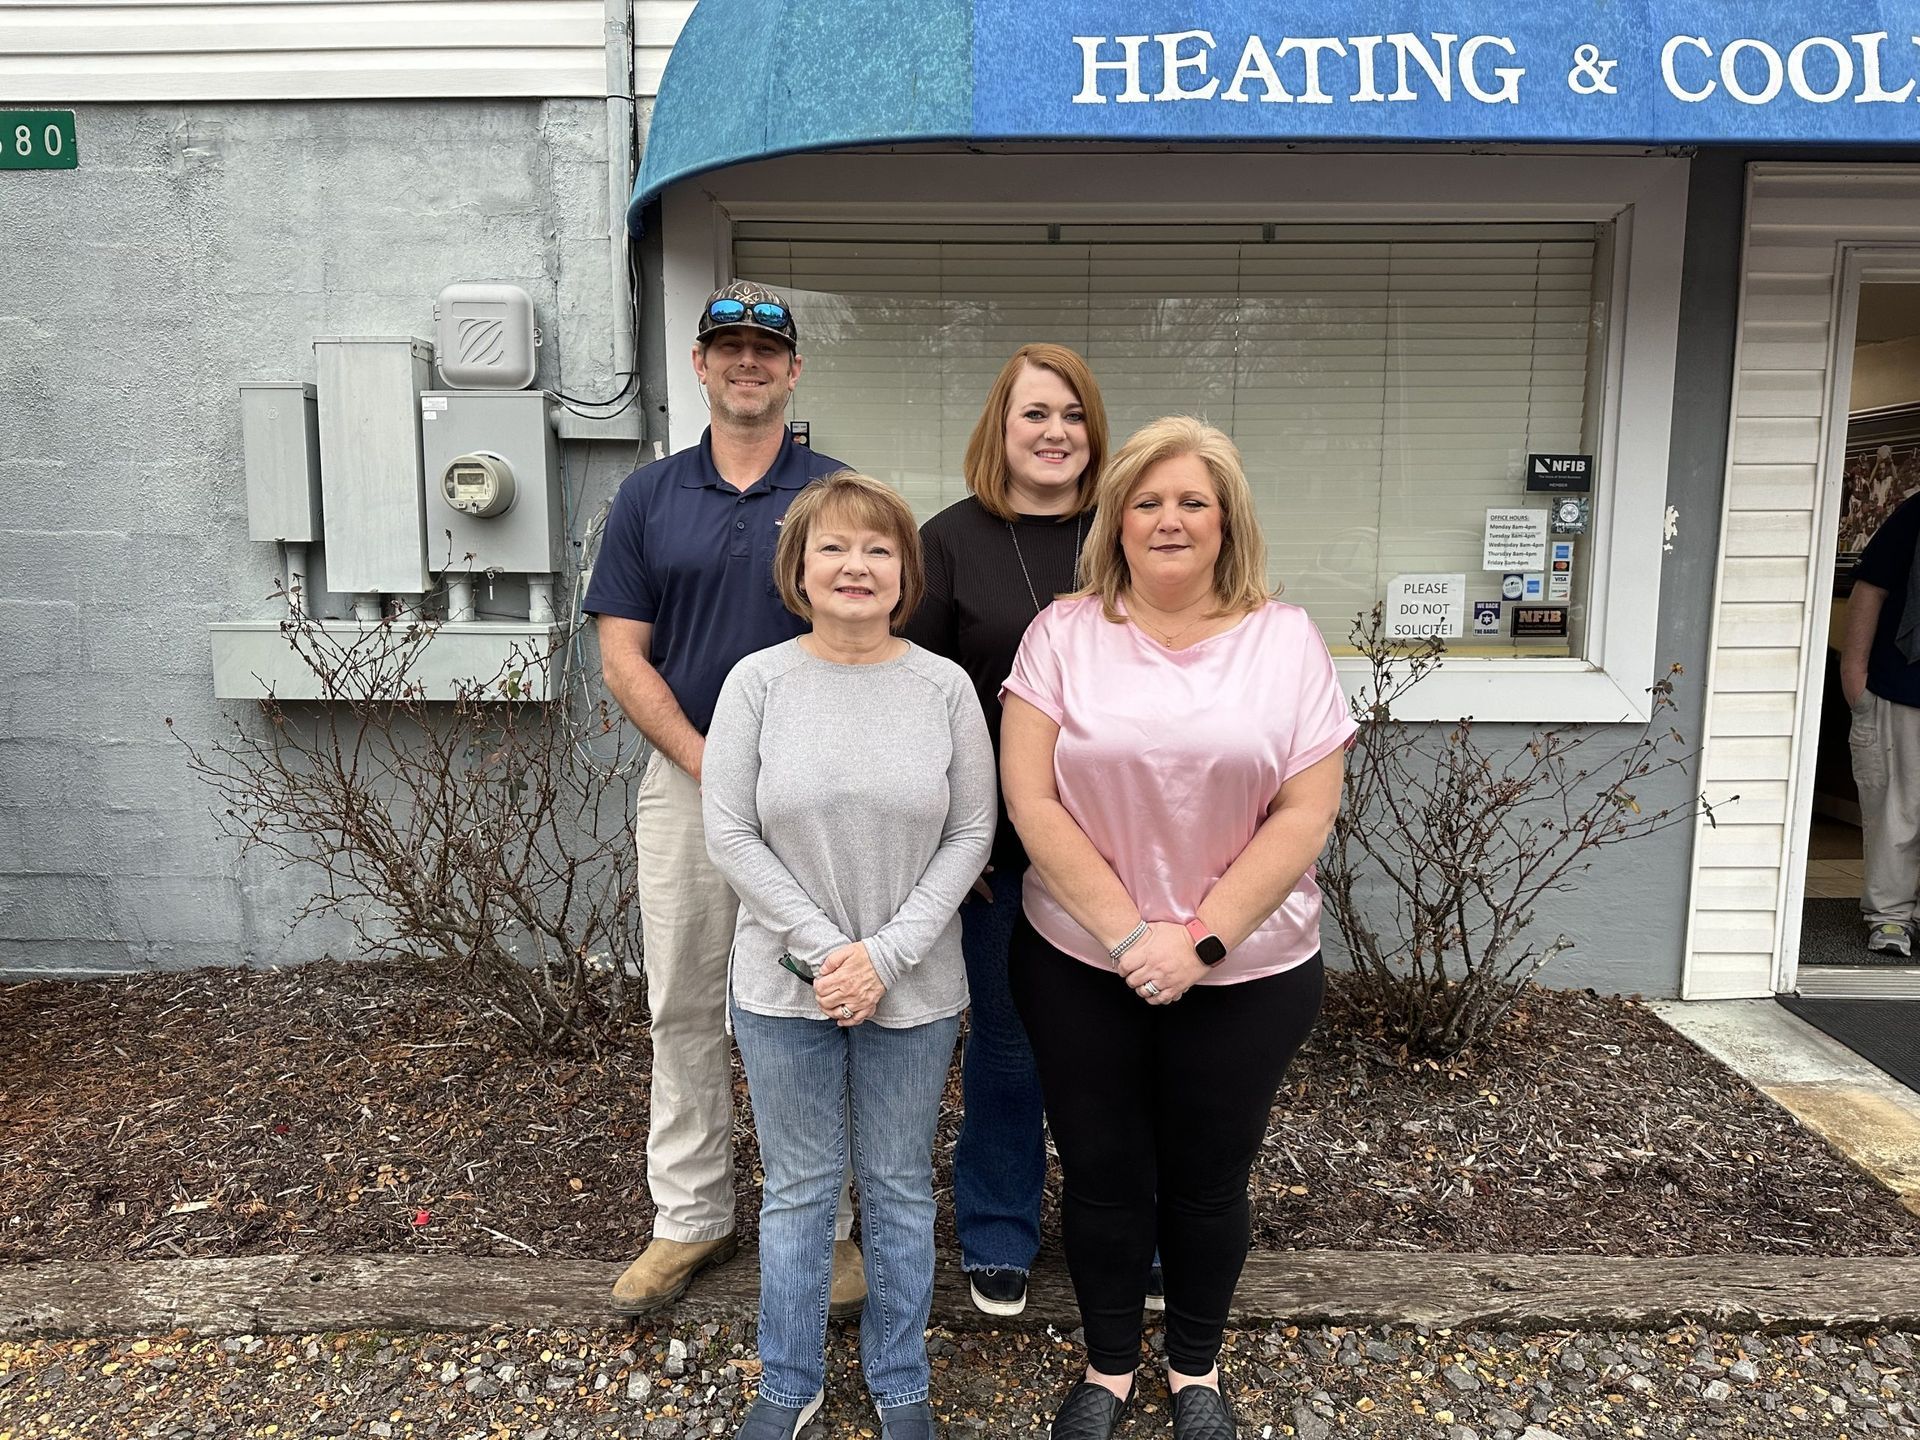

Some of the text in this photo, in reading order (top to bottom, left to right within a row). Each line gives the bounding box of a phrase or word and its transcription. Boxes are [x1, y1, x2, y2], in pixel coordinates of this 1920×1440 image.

[1072, 30, 1920, 105] HEATING & COOL
[0, 124, 62, 156] 80
[1552, 460, 1586, 472] NFIB
[1403, 583, 1449, 594] PLEASE
[1400, 603, 1450, 615] DO NOT
[1519, 610, 1562, 623] NFIB
[1394, 623, 1453, 636] SOLICITE!
